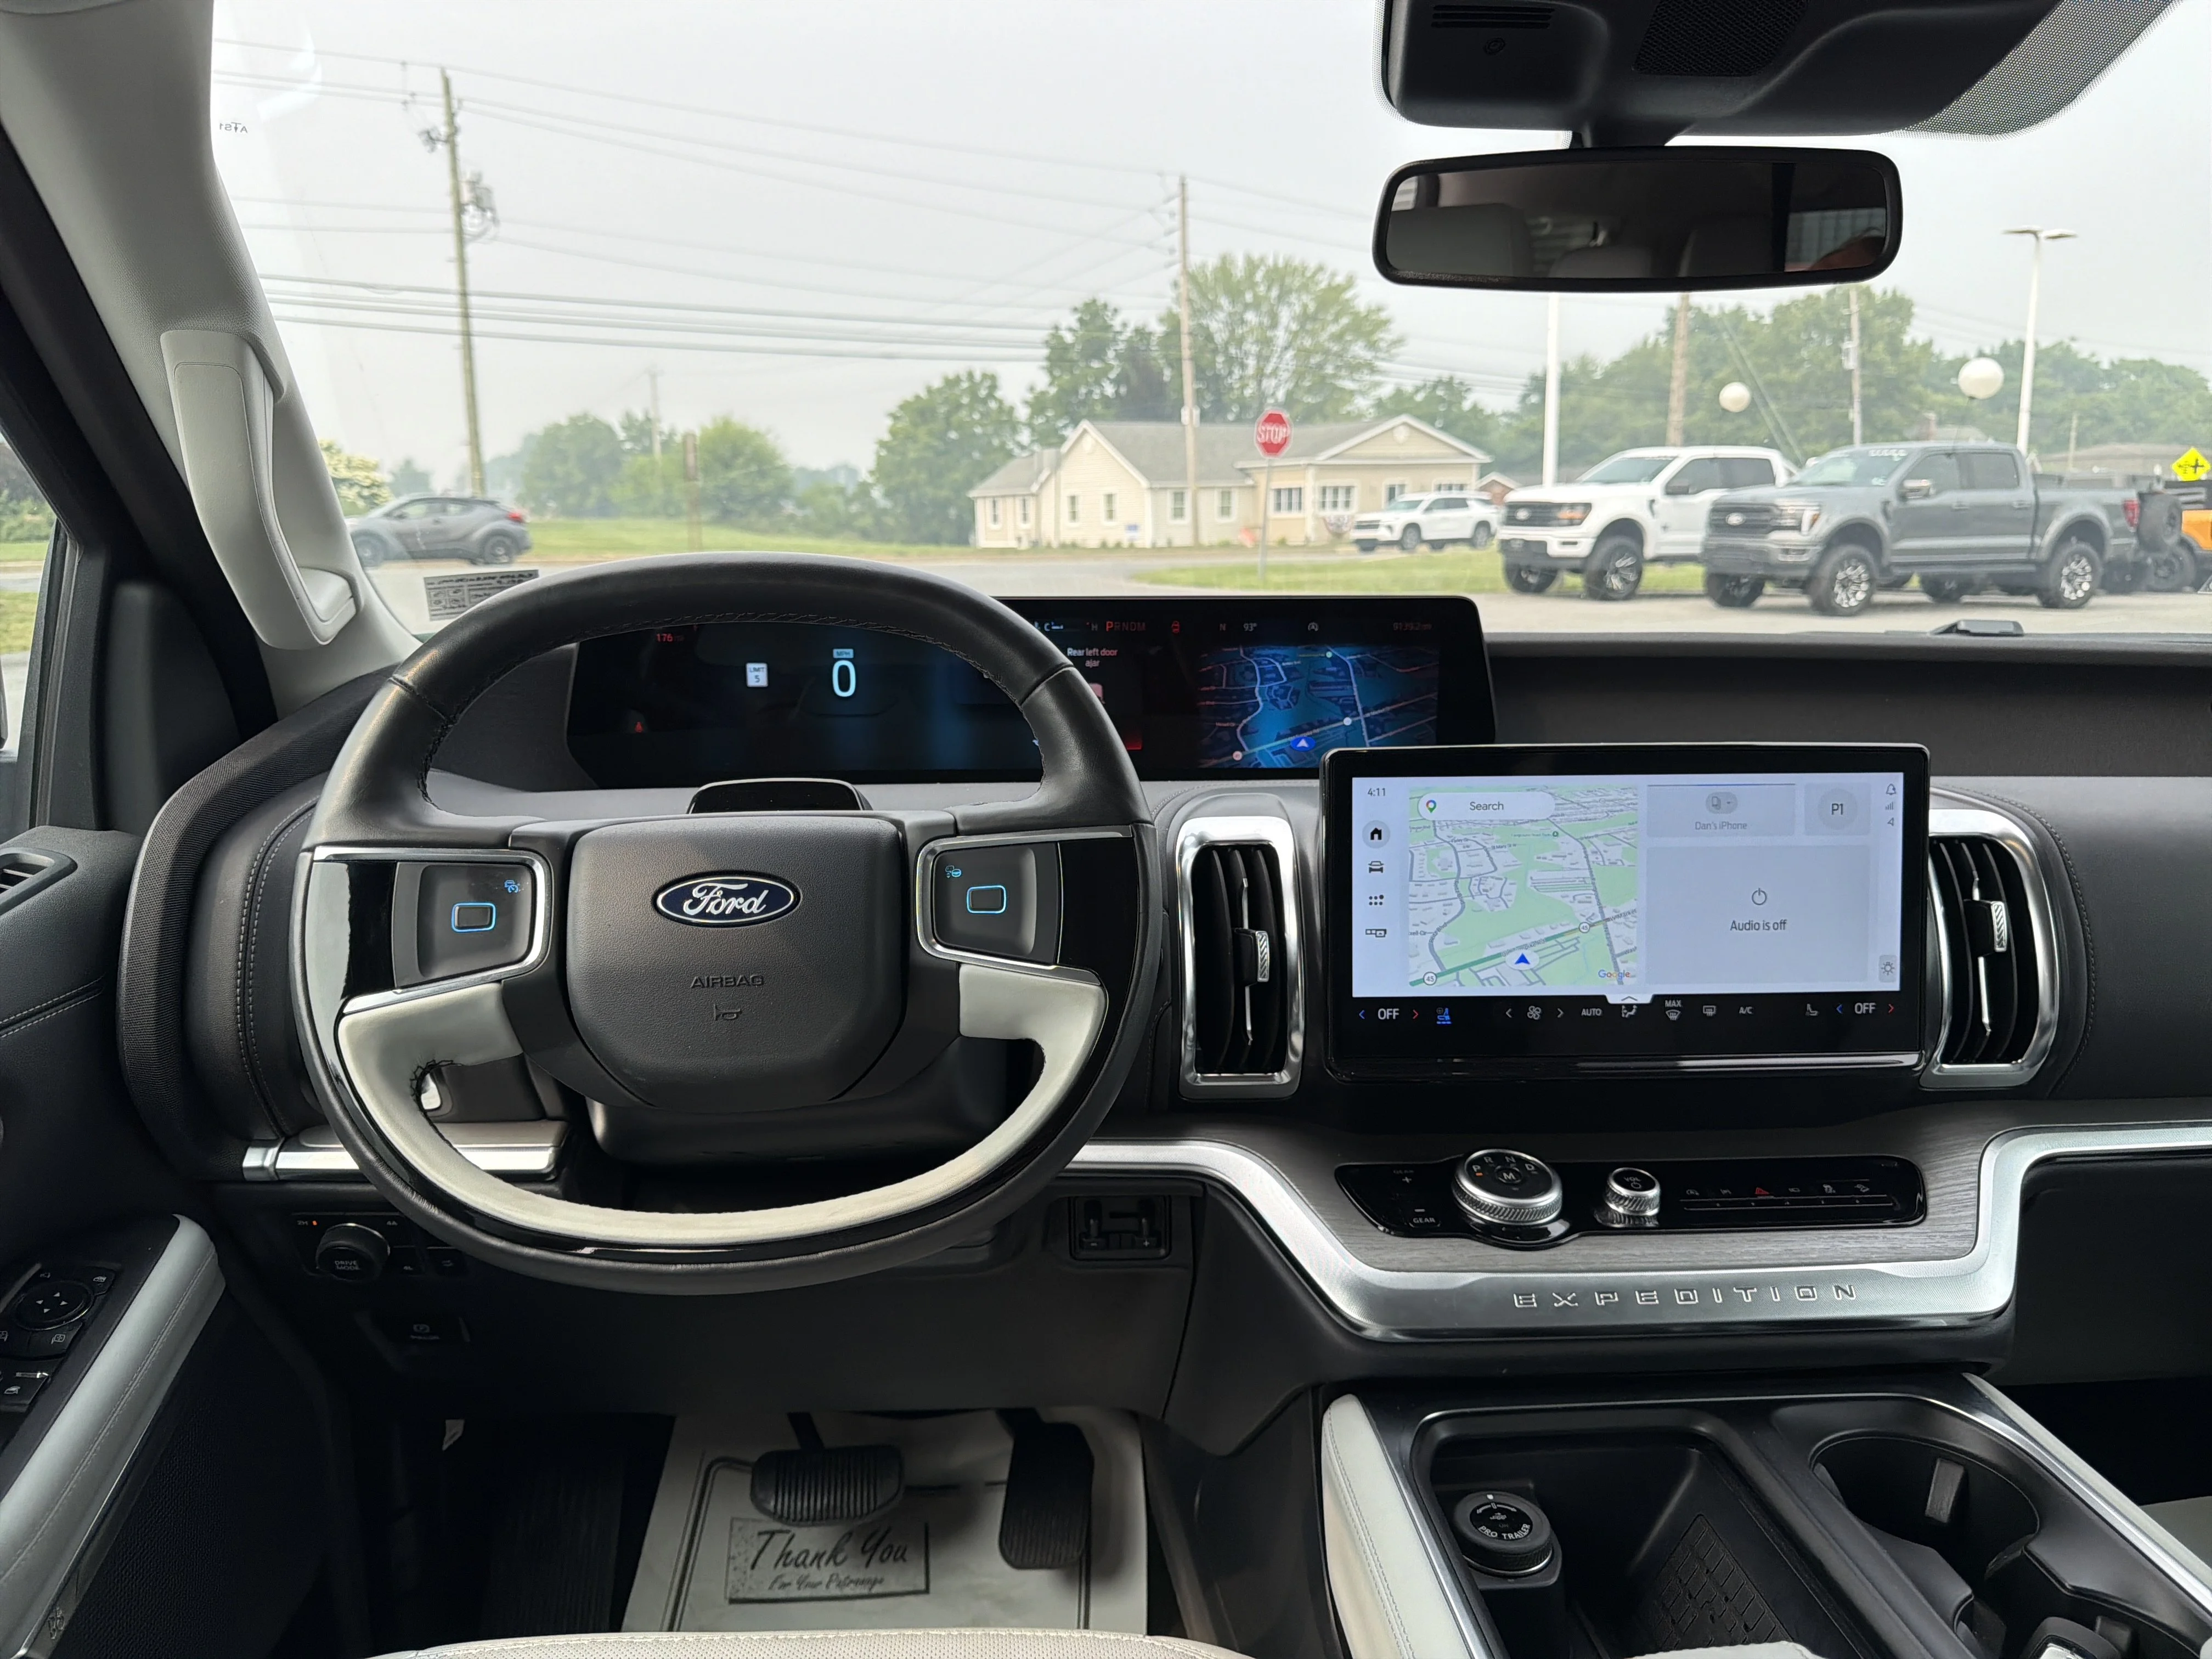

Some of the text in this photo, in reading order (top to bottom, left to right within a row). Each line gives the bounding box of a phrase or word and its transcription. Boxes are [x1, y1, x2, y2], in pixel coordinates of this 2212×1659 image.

[1257, 424, 1287, 444] STOP
[657, 634, 673, 642] 176
[1067, 647, 1118, 656] Rear left door
[1085, 659, 1100, 668] ajar
[832, 660, 856, 697] 0
[1367, 788, 1387, 797] 4:11
[1470, 802, 1504, 811] Search
[1831, 804, 1844, 815] P1
[1695, 822, 1747, 830] Dan's iPhone
[683, 882, 769, 916] Ford
[1616, 909, 1637, 919] Market
[1730, 919, 1787, 931] Audio is off
[690, 974, 765, 988] AIRBAG
[1598, 969, 1630, 981] Google
[1378, 1008, 1400, 1020] OFF
[1854, 1003, 1876, 1014] OFF
[1513, 1284, 1857, 1309] EXPEDITION
[1478, 1523, 1531, 1540] PRO TRAILER
[750, 1526, 909, 1571] Thank You
[768, 1572, 885, 1592] For Your Patronage
